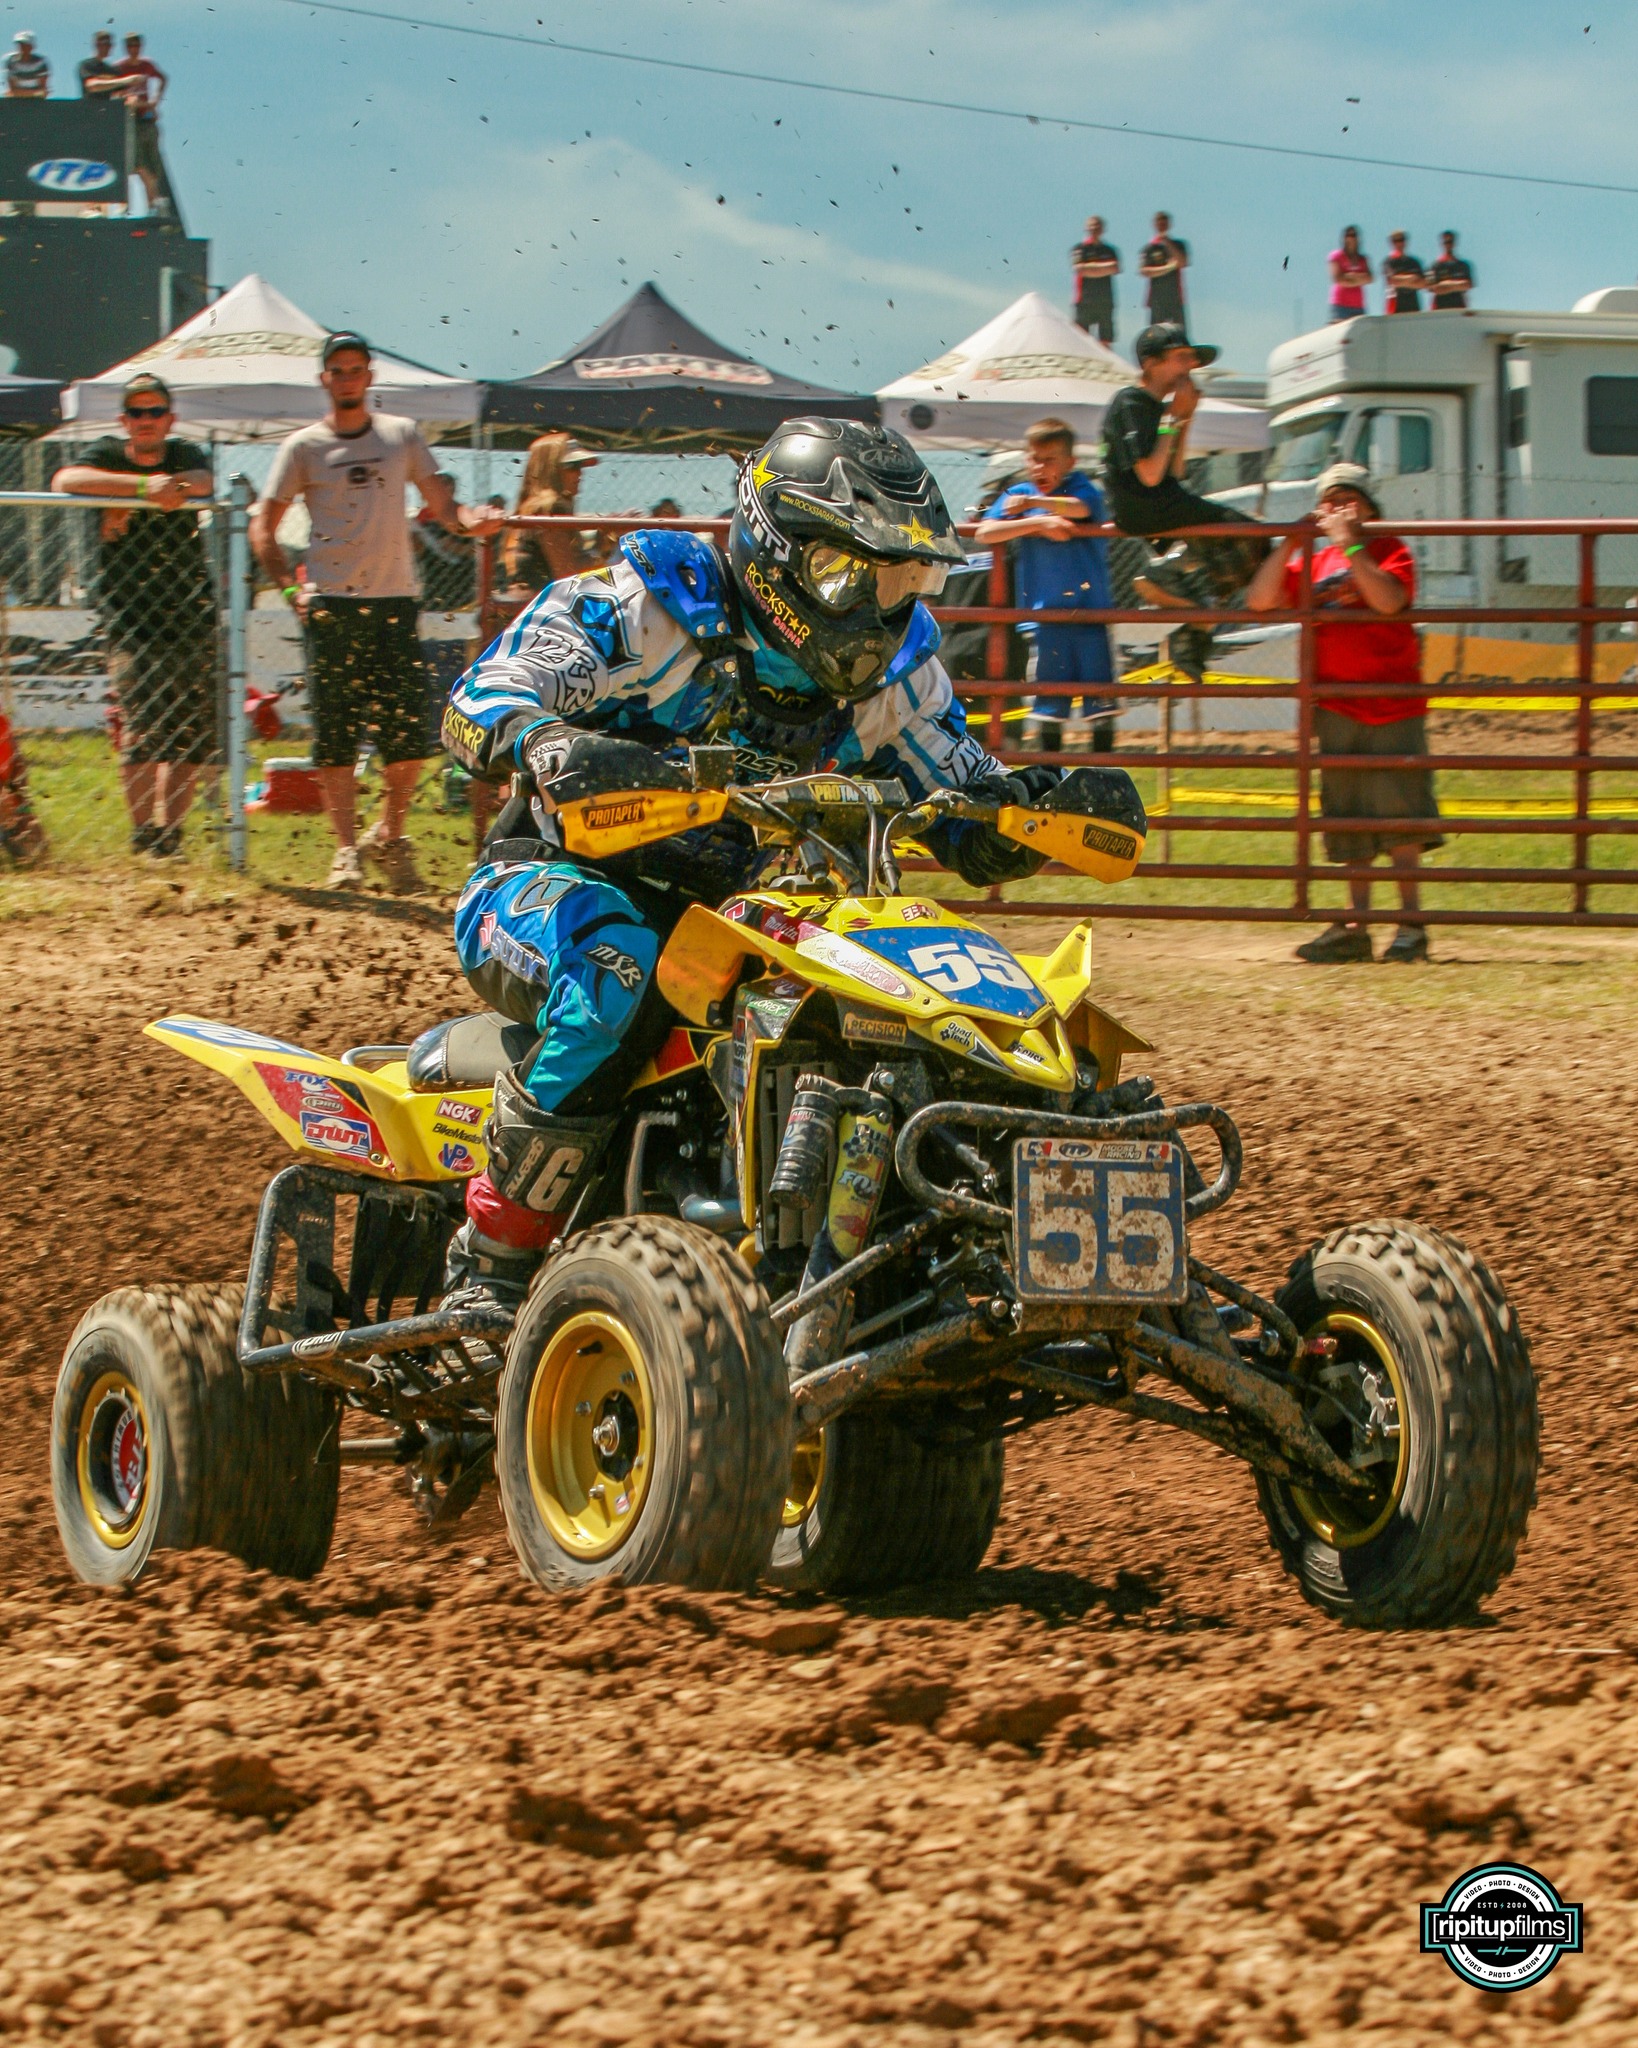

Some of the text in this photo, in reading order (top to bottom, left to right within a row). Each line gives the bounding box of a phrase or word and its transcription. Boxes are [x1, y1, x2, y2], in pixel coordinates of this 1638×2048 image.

[36, 160, 109, 184] ITP
[772, 615, 803, 648] DRINK
[588, 803, 641, 826] PROTAPER
[1085, 829, 1135, 857] PROTAPER
[491, 927, 547, 985] SUZUK
[907, 943, 1034, 992] 55
[948, 1022, 972, 1038] Quad
[950, 1031, 971, 1047] Tech
[284, 1071, 331, 1088] FOX
[439, 1101, 475, 1122] NGK
[306, 1122, 368, 1145] DWT
[433, 1123, 483, 1144] BikeMaste
[441, 1143, 468, 1168] VP
[1101, 1144, 1135, 1152] MOOSE
[1106, 1150, 1141, 1159] RACING
[526, 1146, 584, 1212] G
[1028, 1168, 1174, 1292] 55
